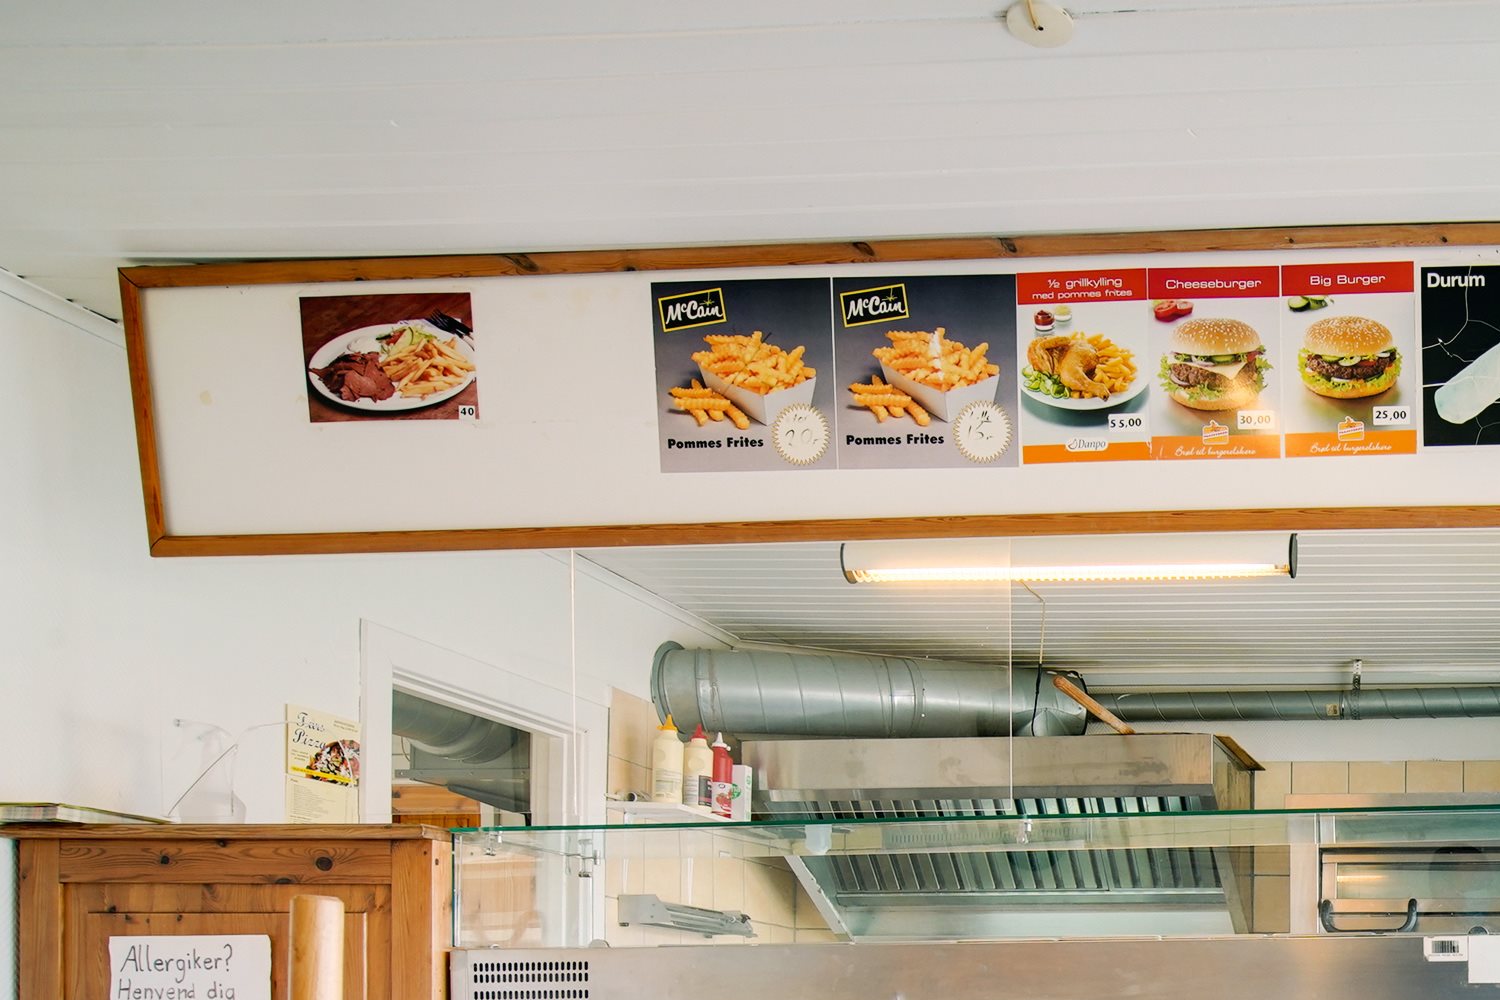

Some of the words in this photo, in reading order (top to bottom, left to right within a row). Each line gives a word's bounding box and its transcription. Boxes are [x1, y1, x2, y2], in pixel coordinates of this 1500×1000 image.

[1065, 277, 1123, 290] grillkylling
[1165, 278, 1262, 290] Cheeseburger
[1310, 275, 1332, 287] Big
[1337, 274, 1386, 286] Burger
[1427, 272, 1485, 288] Durum
[1032, 291, 1054, 300] med
[1058, 290, 1101, 300] pommes
[1104, 288, 1132, 297] frites
[666, 300, 723, 324] McCain
[847, 295, 905, 320] McCain
[460, 407, 474, 416] 40
[1375, 410, 1407, 421] 25,00
[1239, 415, 1271, 426] 30,00
[667, 438, 722, 449] Pommes
[727, 436, 764, 448] Frites
[846, 434, 902, 446] Pommes
[906, 433, 944, 445] Frites
[1078, 438, 1107, 450] Danpo
[120, 943, 233, 983] Allergiker?
[118, 978, 197, 1000] Henvend
